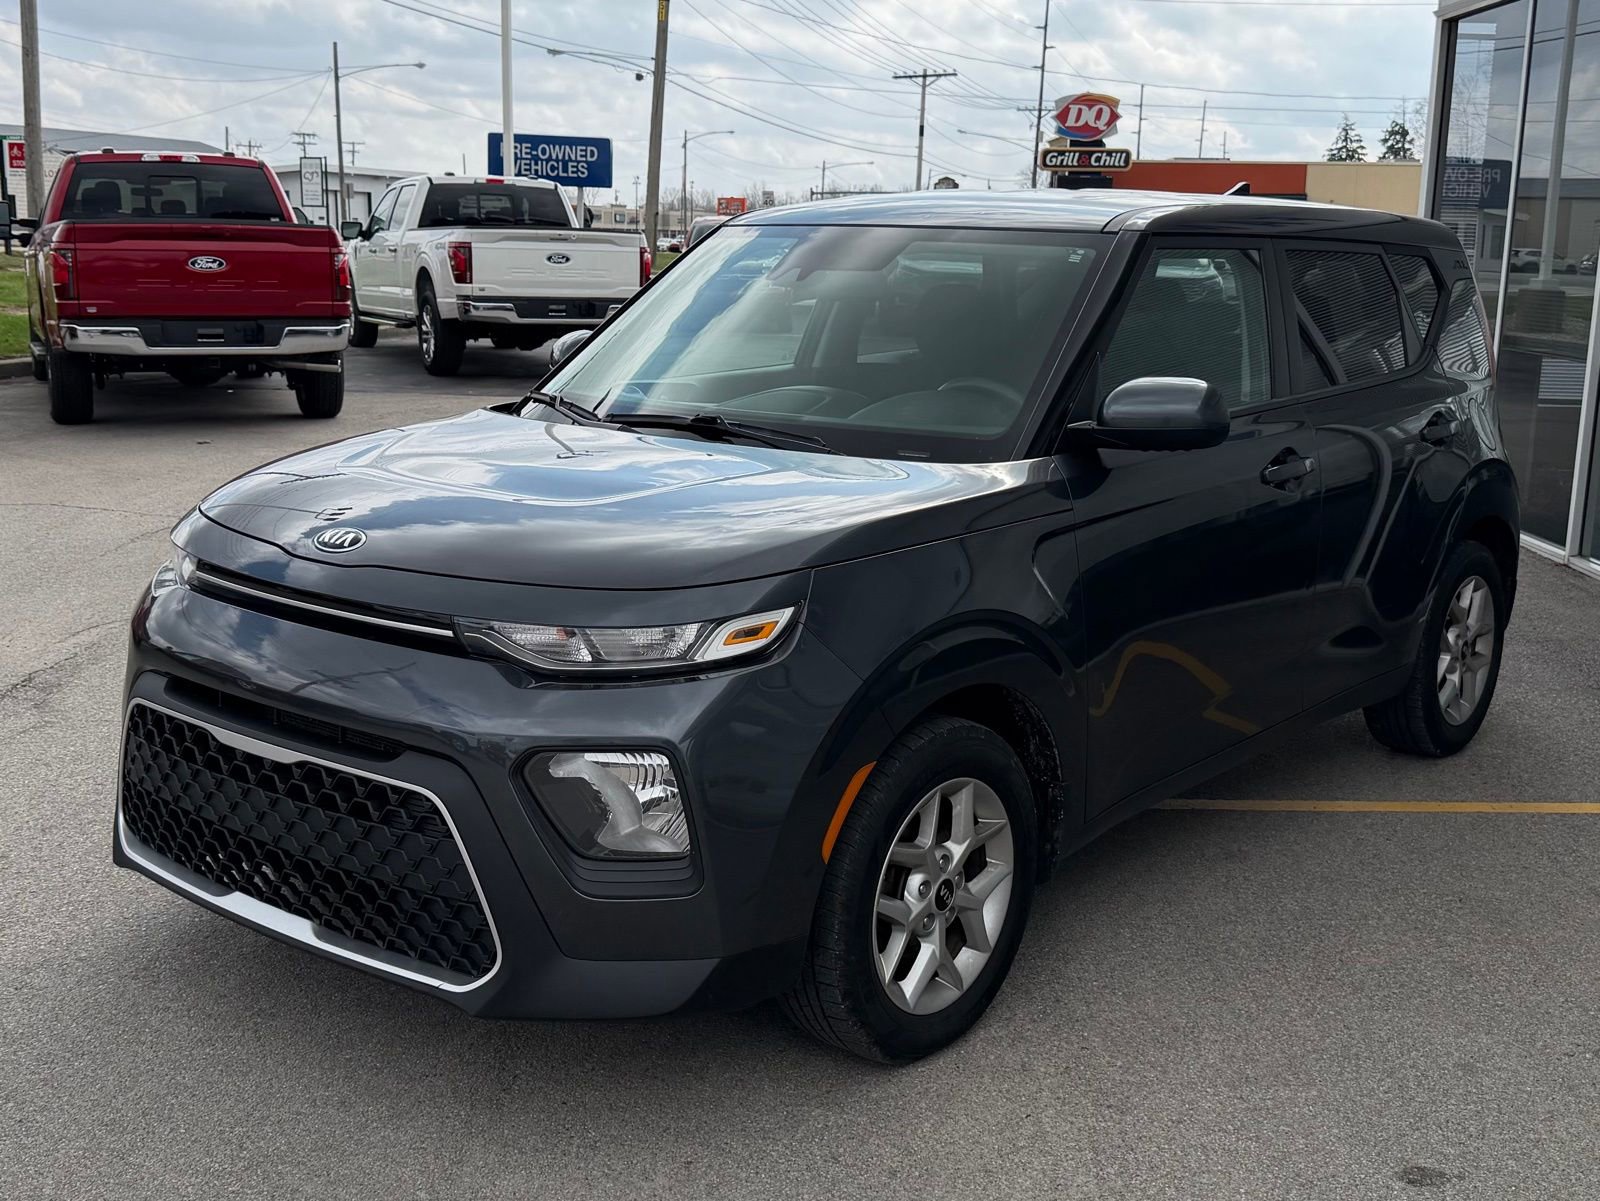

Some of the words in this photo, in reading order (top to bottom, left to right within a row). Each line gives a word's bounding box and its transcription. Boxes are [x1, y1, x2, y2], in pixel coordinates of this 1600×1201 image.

[1065, 104, 1111, 130] DQ
[500, 142, 598, 162] RE-OWNED
[1045, 152, 1079, 166] Grill
[1090, 152, 1126, 166] Chill
[318, 529, 356, 548] KIA
